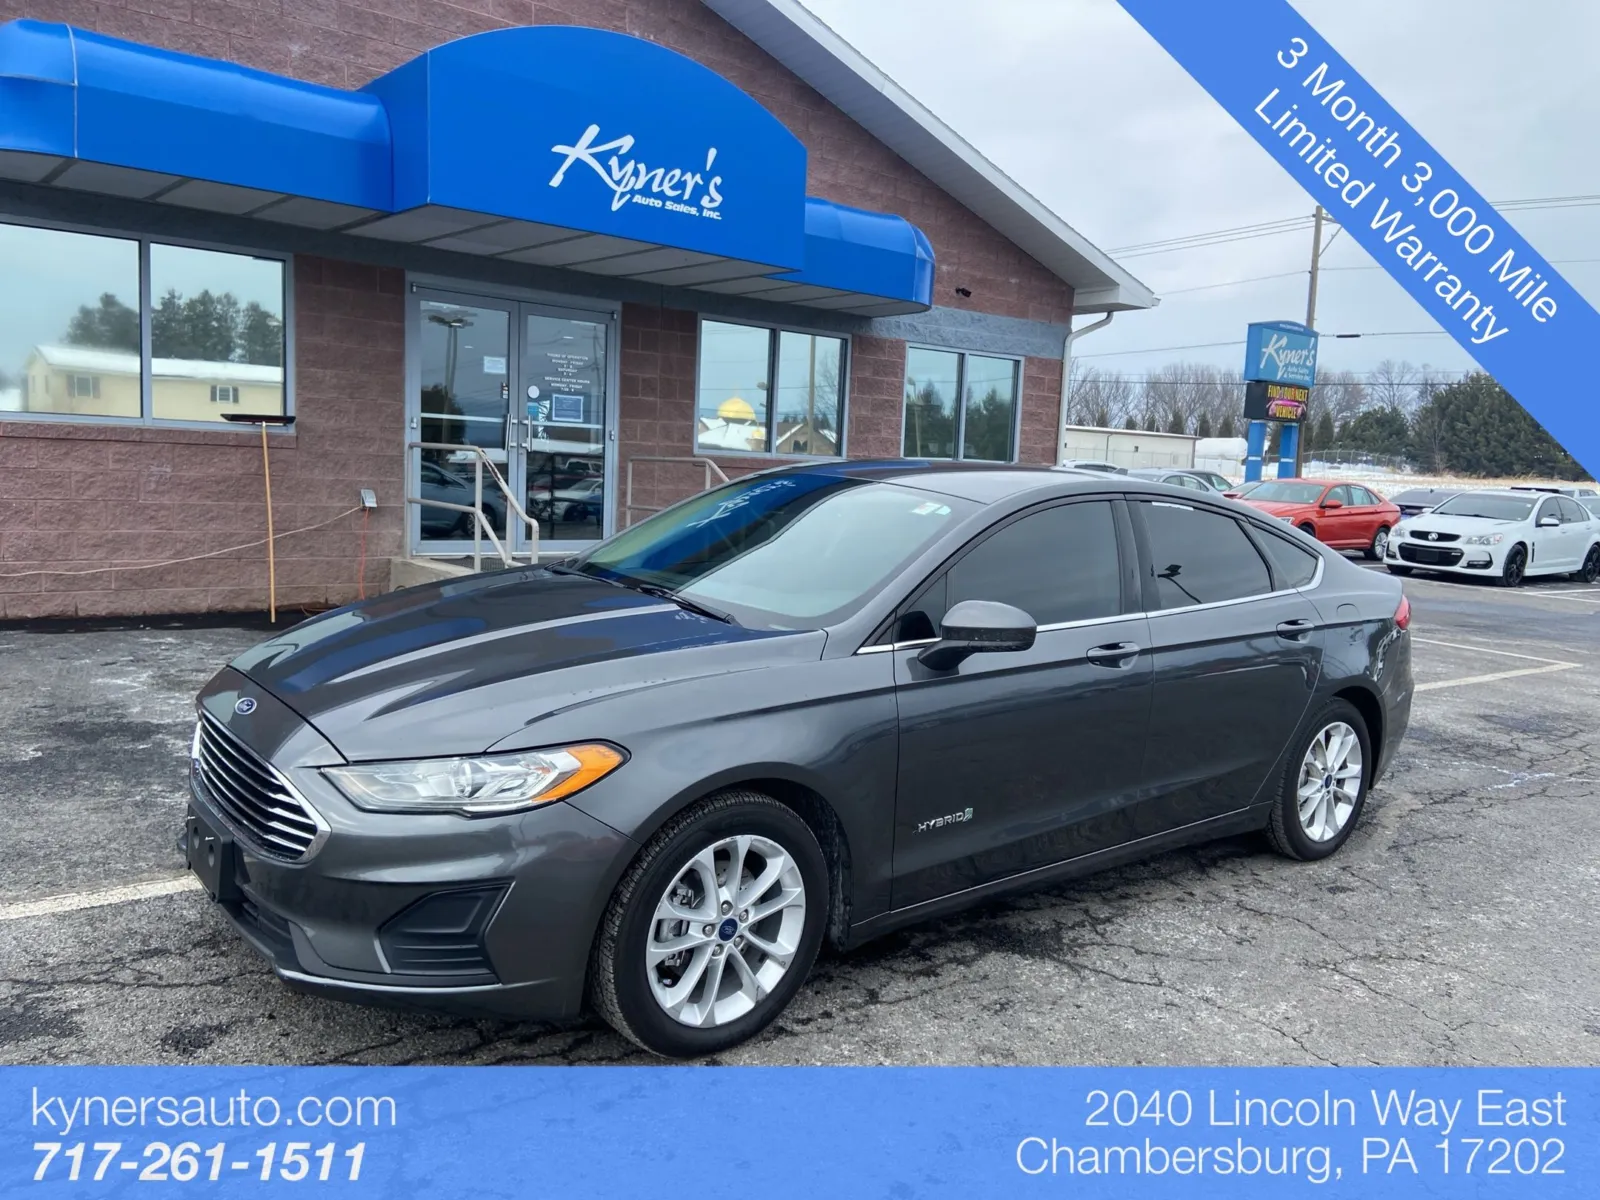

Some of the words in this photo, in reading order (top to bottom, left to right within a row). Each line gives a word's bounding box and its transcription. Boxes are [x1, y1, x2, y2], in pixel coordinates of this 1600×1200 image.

[549, 124, 724, 212] Kyner's
[632, 194, 662, 208] Auto
[665, 201, 699, 216] Sales,
[703, 208, 722, 220] Inc.
[1260, 334, 1315, 380] Kyner's
[918, 812, 964, 832] HYBRID
